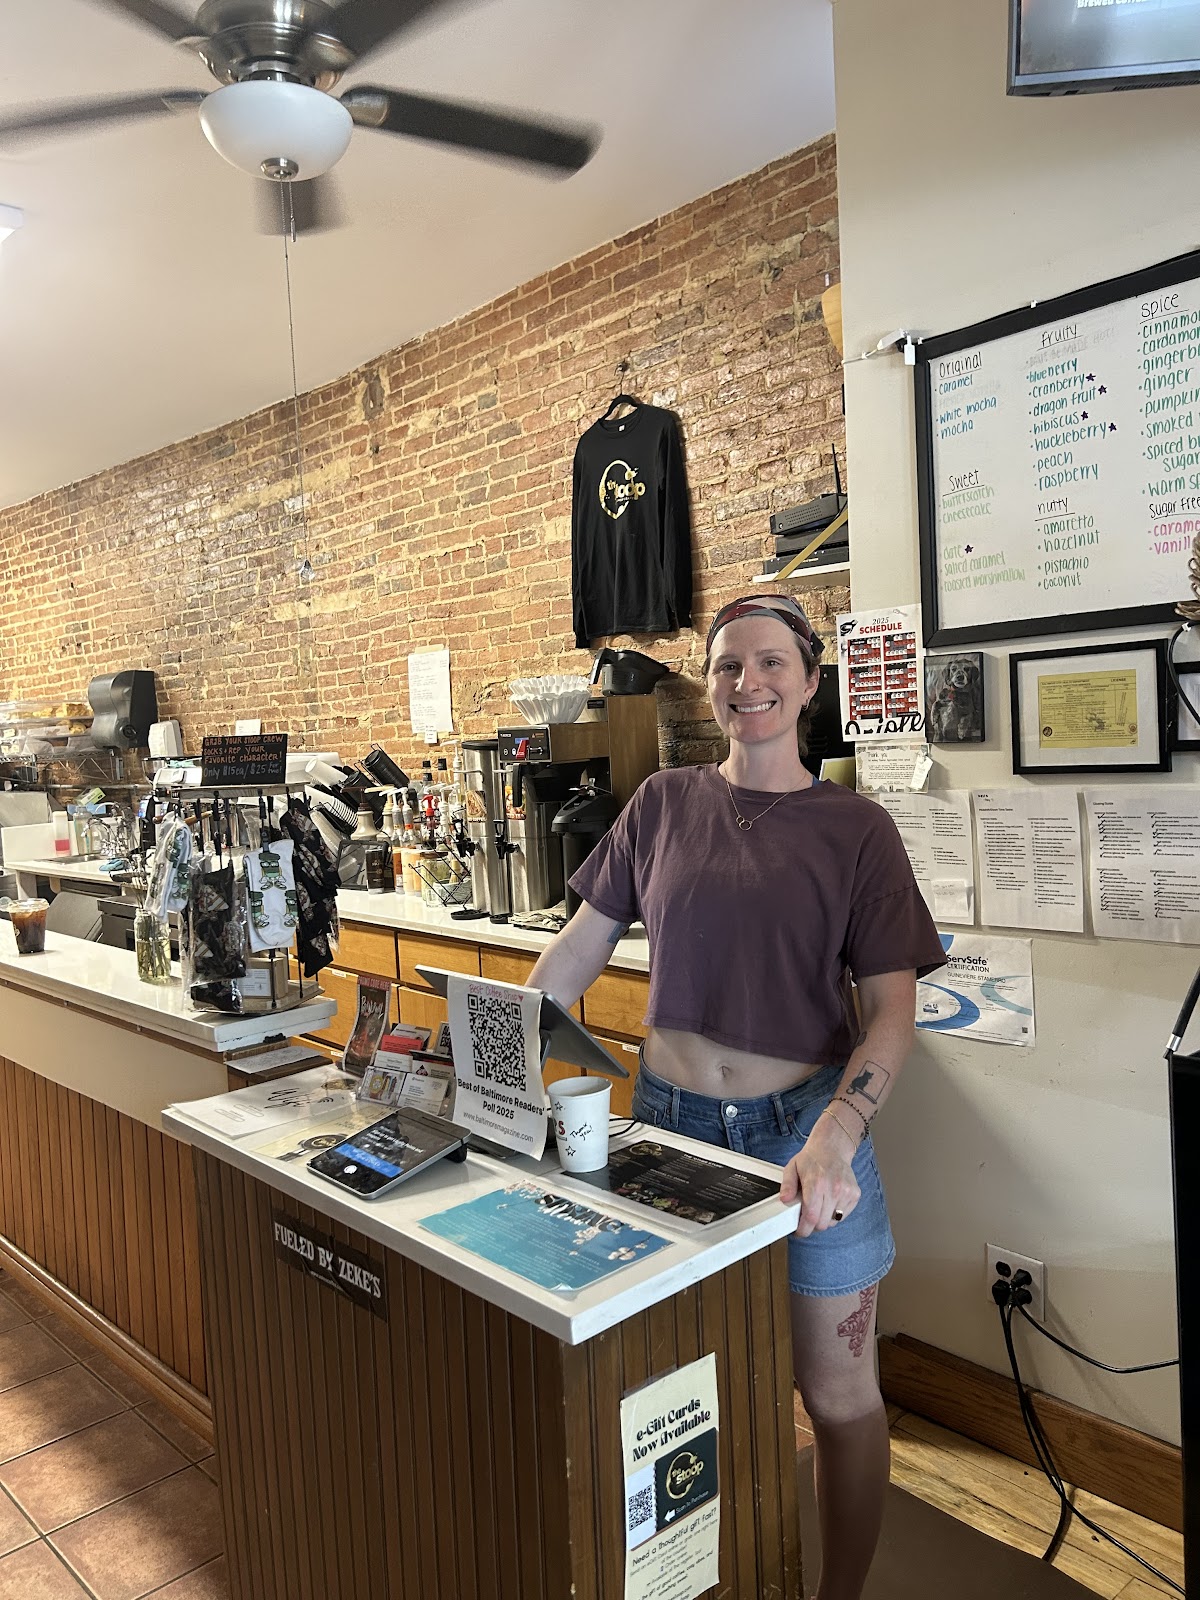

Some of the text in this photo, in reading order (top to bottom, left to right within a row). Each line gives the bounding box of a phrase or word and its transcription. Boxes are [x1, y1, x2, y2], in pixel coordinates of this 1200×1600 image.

[1141, 293, 1179, 319] Spice
[1143, 309, 1200, 338] cinnamo
[939, 351, 982, 378] Original
[1143, 343, 1200, 375] gingerb
[939, 374, 973, 396] caramel
[1032, 373, 1084, 398] cranberry
[1144, 367, 1194, 398] ginger
[940, 407, 962, 424] white
[966, 396, 997, 416] mocha
[1033, 385, 1097, 417] dragon fruit
[941, 419, 974, 439] mocha
[1033, 411, 1079, 435] hibiscus
[1147, 411, 1193, 438] smoked
[1035, 421, 1107, 452] huckleberry
[1147, 436, 1183, 460] spiced
[1037, 451, 1073, 472] peach
[1163, 451, 1200, 472] sugar
[948, 469, 979, 492] Sweet
[1039, 463, 1098, 491] raspberry
[1148, 476, 1186, 497] warm
[942, 502, 992, 524] cheesecake
[1149, 500, 1177, 519] Sugar
[1043, 514, 1094, 536] amaretto
[1154, 520, 1200, 537] carame
[1044, 529, 1100, 552] hazelnut
[1154, 535, 1190, 555] vanill
[1044, 556, 1089, 575] pistachio
[1043, 572, 1081, 590] coconut
[859, 622, 902, 635] SCHEDULE
[872, 617, 889, 626] 2025
[946, 954, 988, 966] ServSafe
[947, 963, 989, 973] CERTIFICATION
[457, 1078, 545, 1116] Best of Baltimore Readers'
[482, 1100, 514, 1120] Poll 2025
[463, 1110, 534, 1142] www.baltimoremagazine.com
[274, 1221, 315, 1261] FUELED
[317, 1246, 334, 1272] BY
[338, 1256, 382, 1299] ZEKE'S
[636, 1399, 701, 1441] e-Gift Cards
[632, 1410, 711, 1462] Now Available
[632, 1549, 650, 1567] Need
[658, 1525, 689, 1550] thoughtful
[690, 1516, 701, 1532] gift
